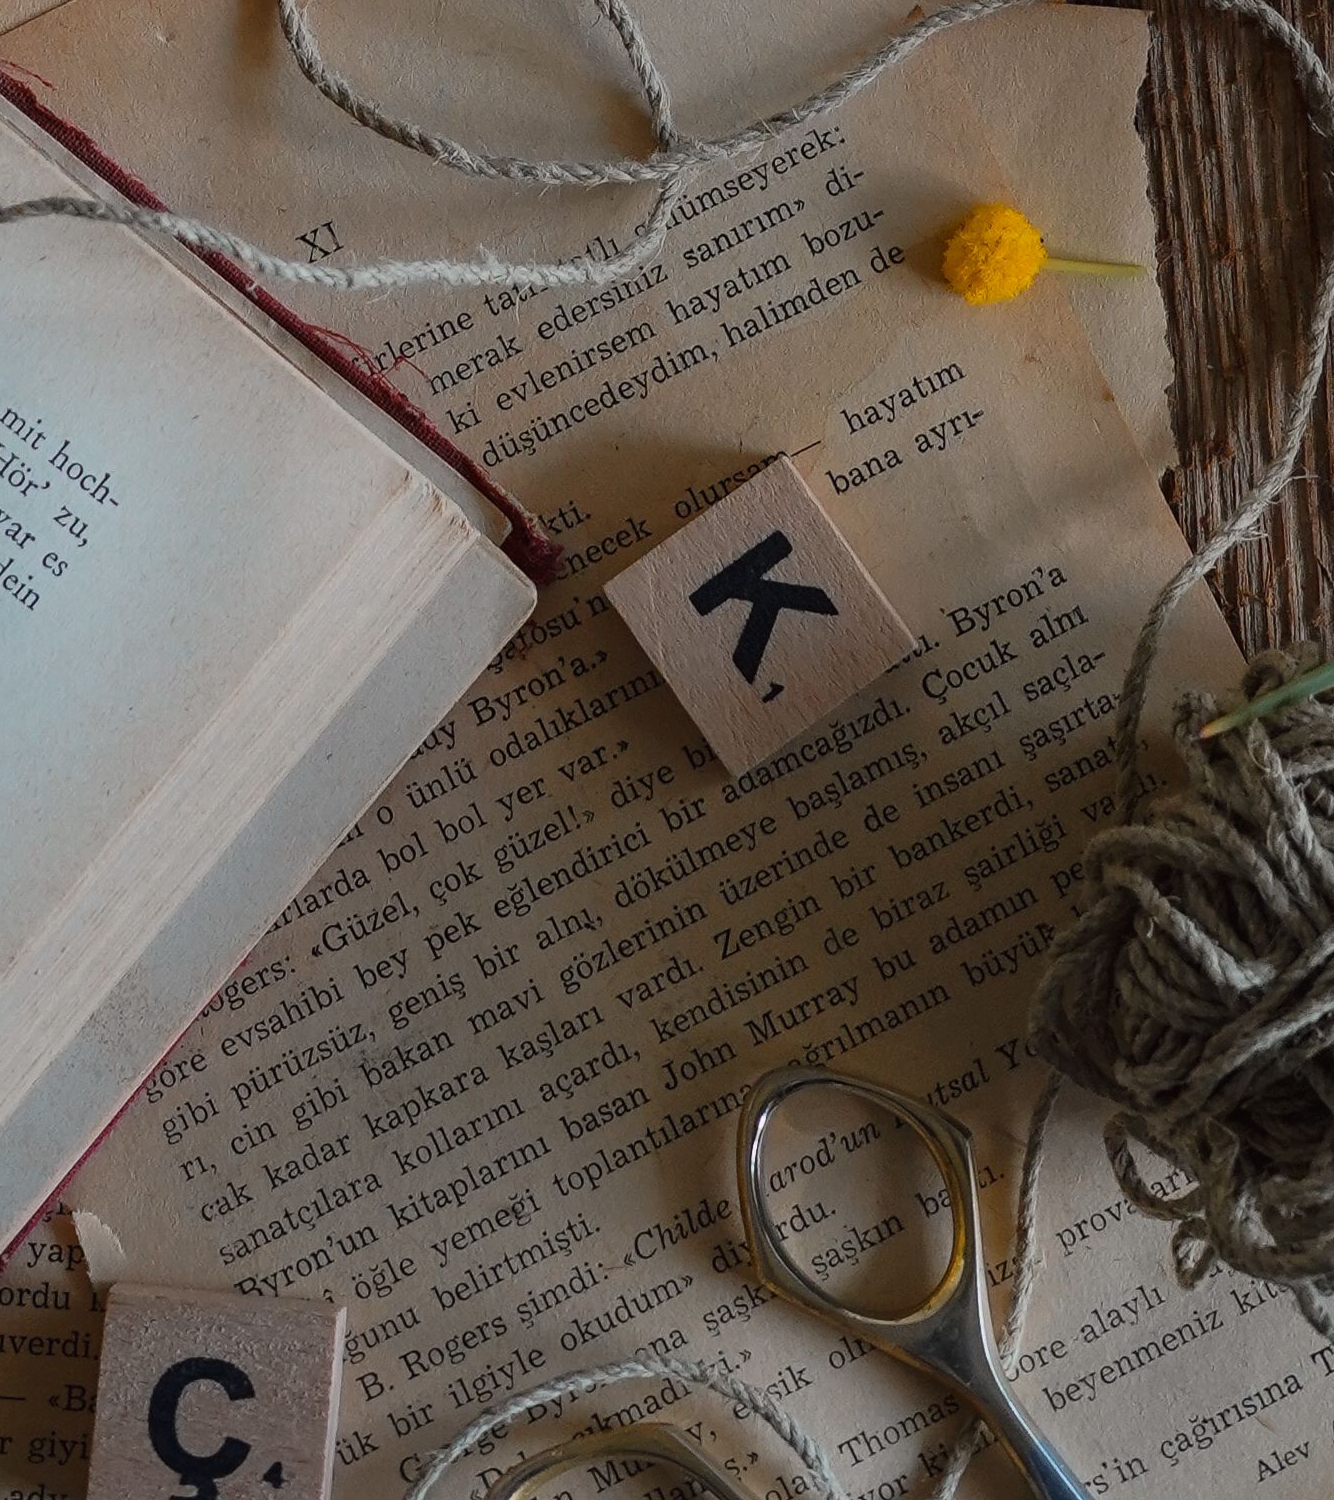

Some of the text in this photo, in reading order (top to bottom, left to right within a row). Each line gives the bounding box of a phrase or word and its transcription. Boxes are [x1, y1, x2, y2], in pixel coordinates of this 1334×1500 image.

[295, 219, 344, 263] XI
[663, 209, 885, 326] hayatım bozu-
[481, 245, 907, 468] düşüncedeydim, halimden de
[47, 438, 120, 508] hoch-
[688, 529, 840, 687] K
[360, 785, 1034, 1140] kapkara kaşları vardı. Zengin bir bankerdi,
[385, 887, 1039, 1232] kitaplarını basan John Murray bu adamın
[1256, 1439, 1311, 1484] Alev
